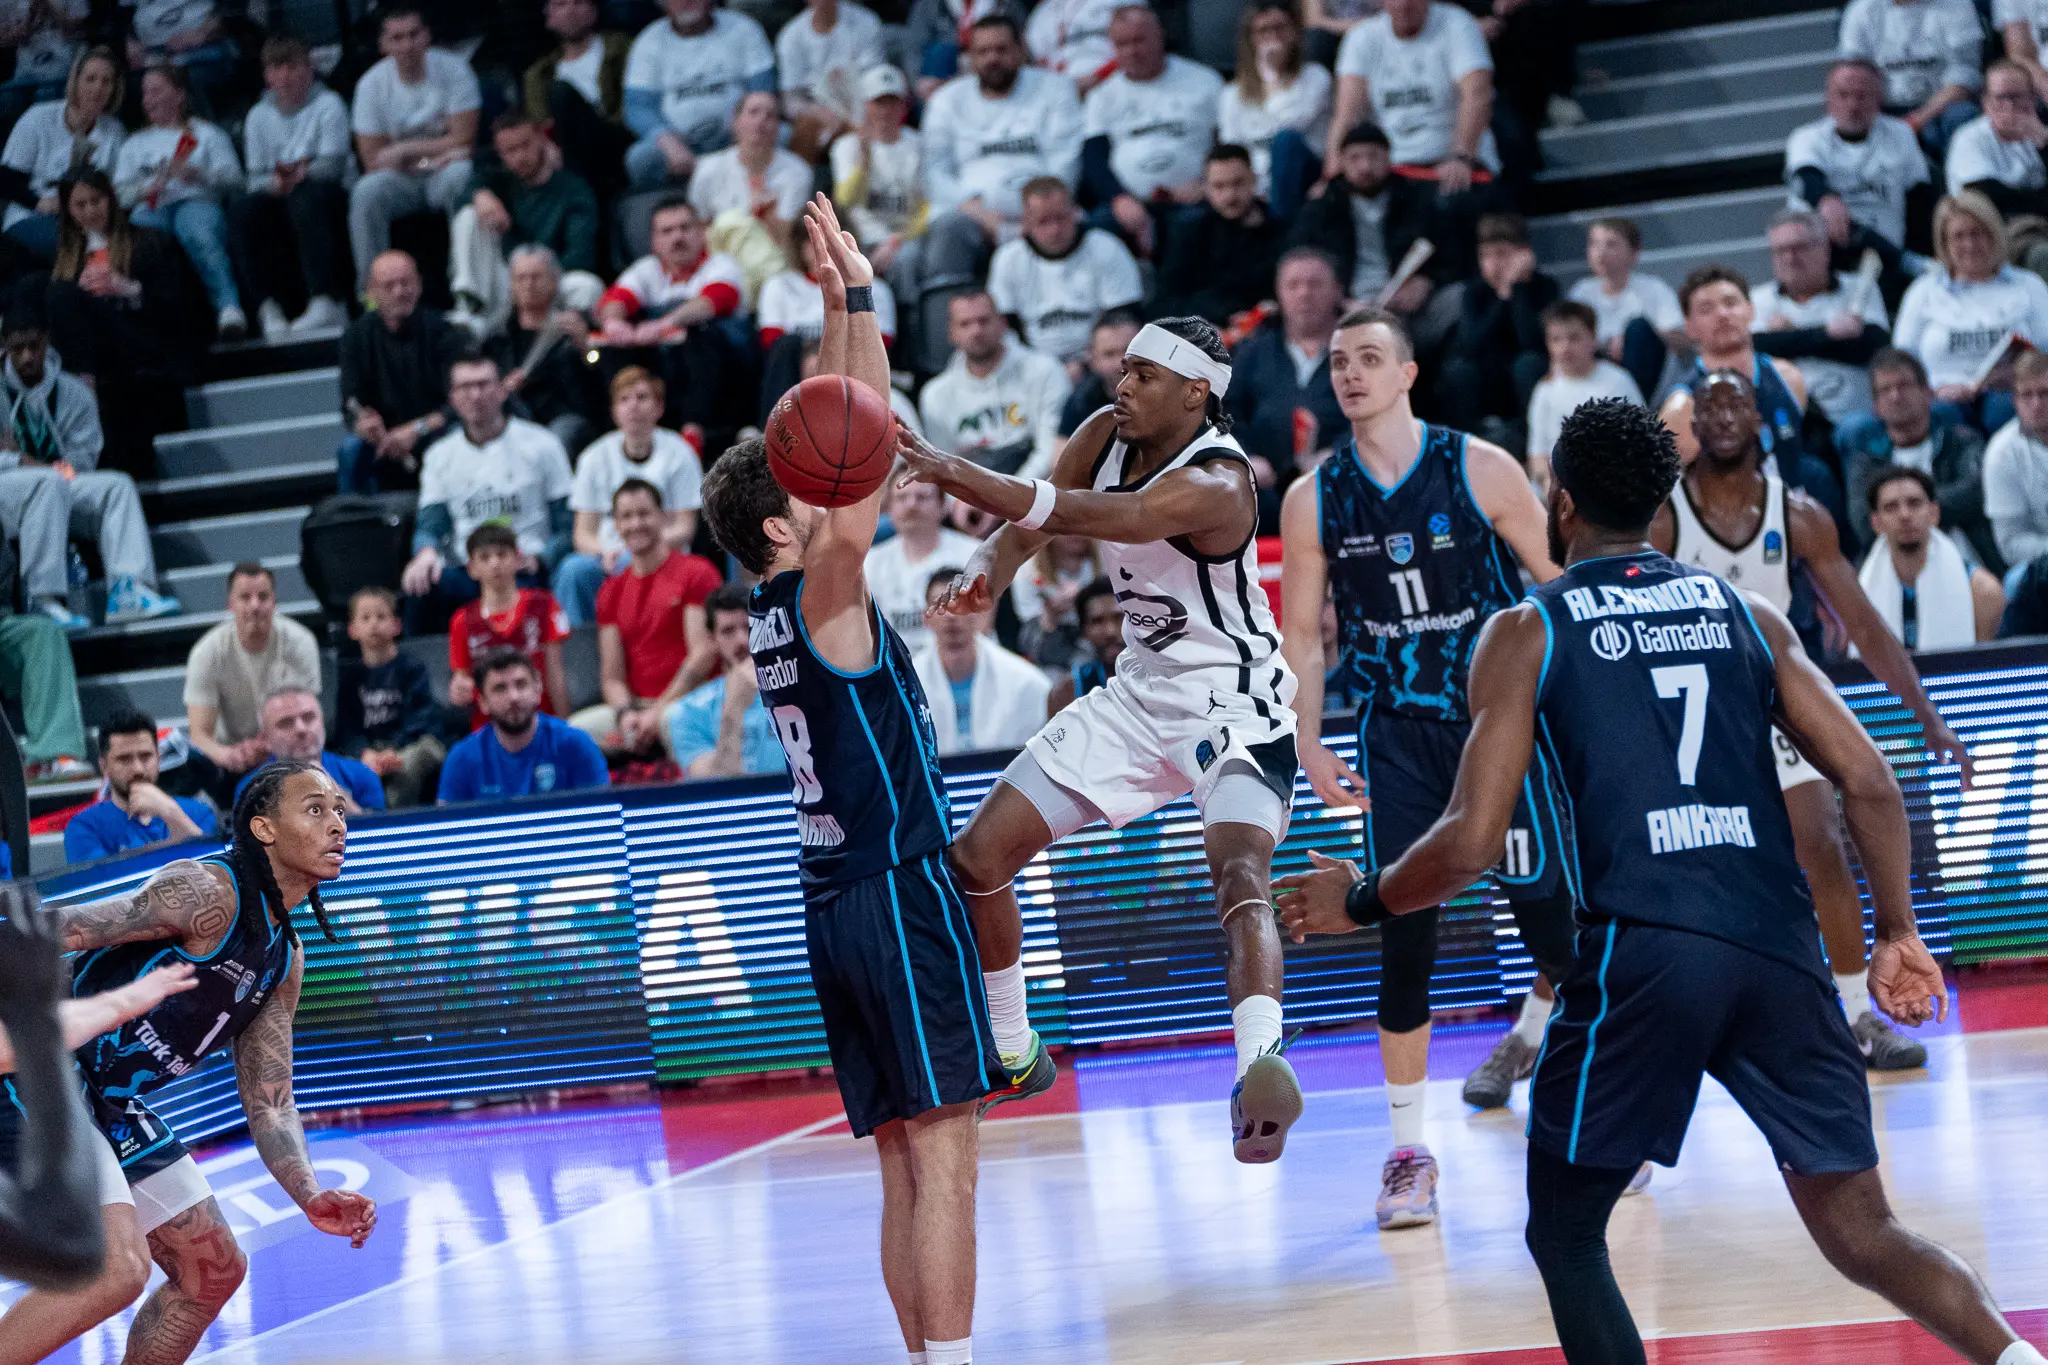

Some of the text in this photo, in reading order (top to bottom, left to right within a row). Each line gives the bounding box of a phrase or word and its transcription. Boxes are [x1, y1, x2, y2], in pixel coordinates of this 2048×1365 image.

[1388, 568, 1430, 616] 11
[1401, 607, 1476, 635] Telekom
[1632, 615, 1732, 653] Gamador
[1650, 663, 1710, 787] 7
[1646, 803, 1756, 855] ANKARA
[134, 1019, 172, 1062] Türk
[193, 1011, 231, 1057] 1
